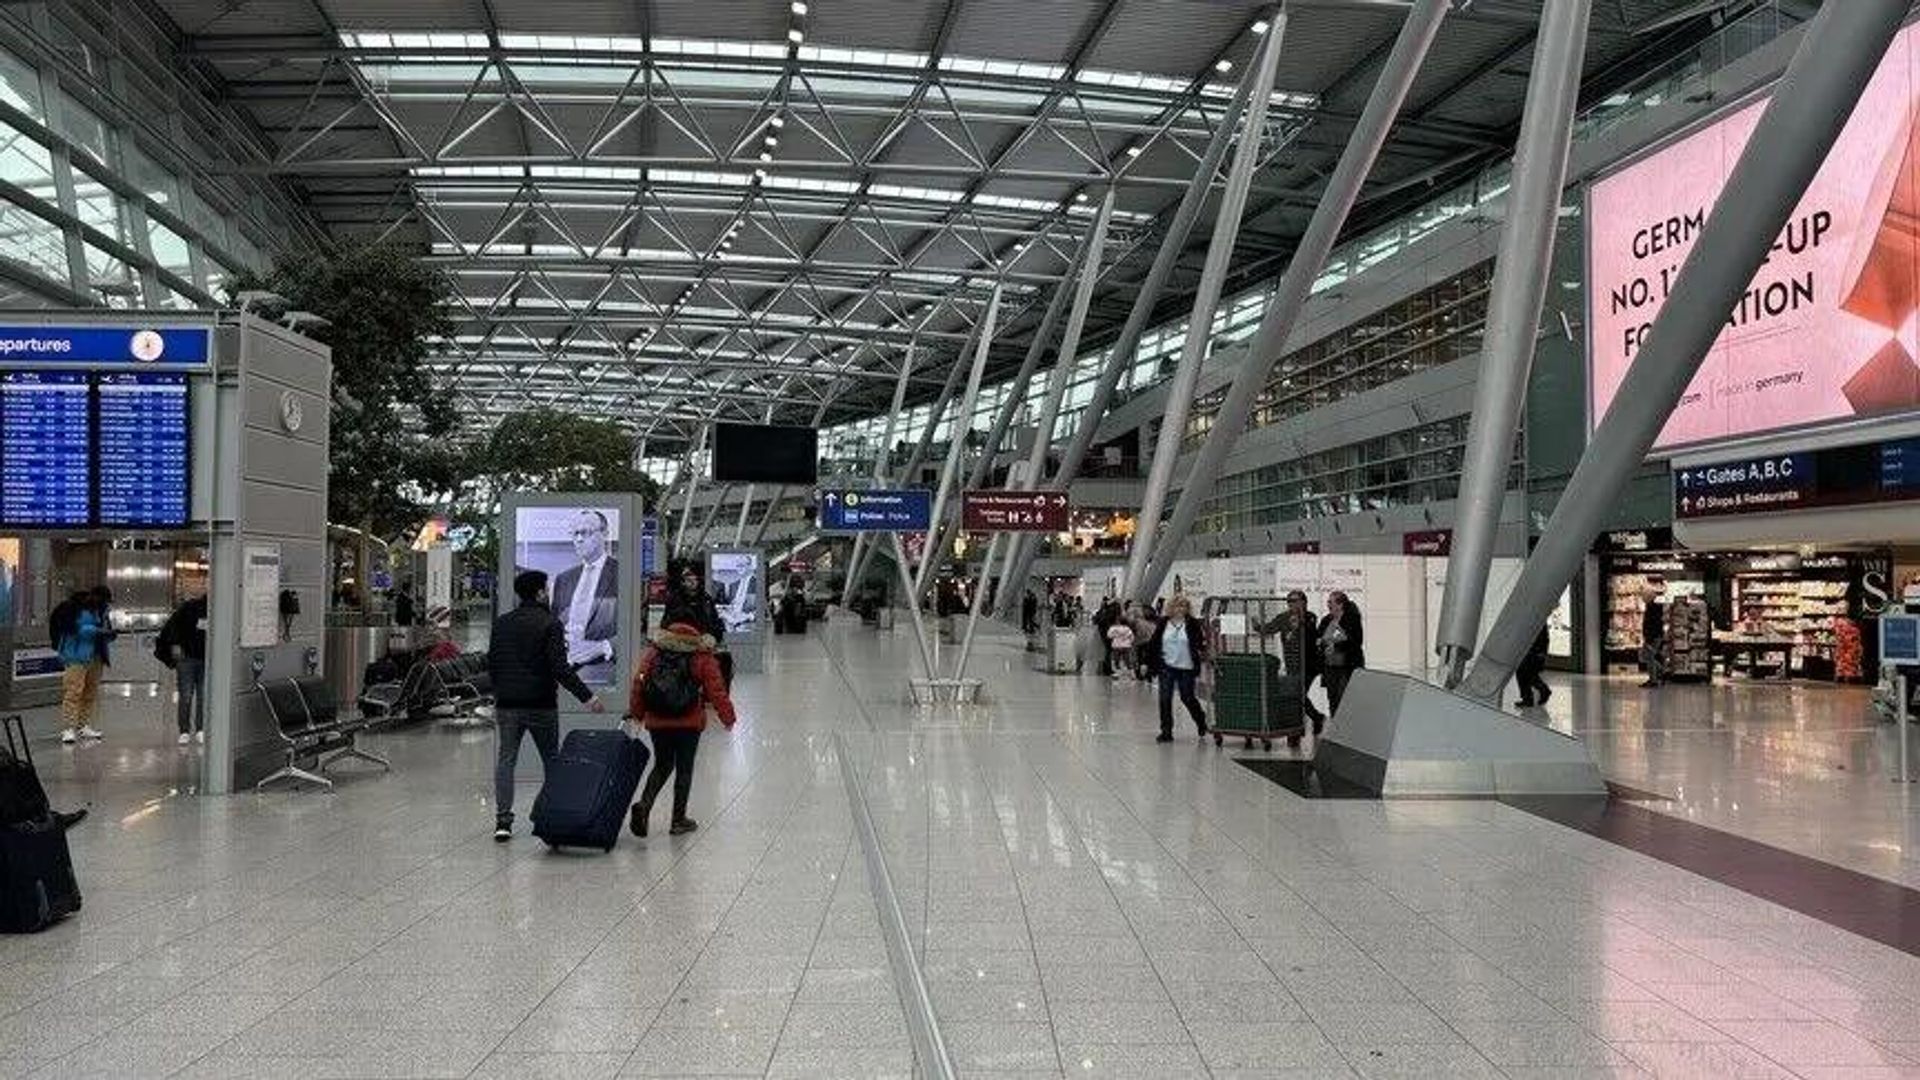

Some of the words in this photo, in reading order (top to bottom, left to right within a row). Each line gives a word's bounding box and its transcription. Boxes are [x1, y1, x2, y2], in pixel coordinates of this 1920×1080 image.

[1632, 206, 1705, 260] GERM
[1611, 277, 1655, 315] NO.
[1756, 371, 1803, 391] germany
[1706, 467, 1746, 484] Gates
[1748, 457, 1793, 482] A,B,C
[860, 495, 903, 504] Information
[1706, 495, 1734, 508] Shops
[1743, 489, 1800, 504] Restaurants
